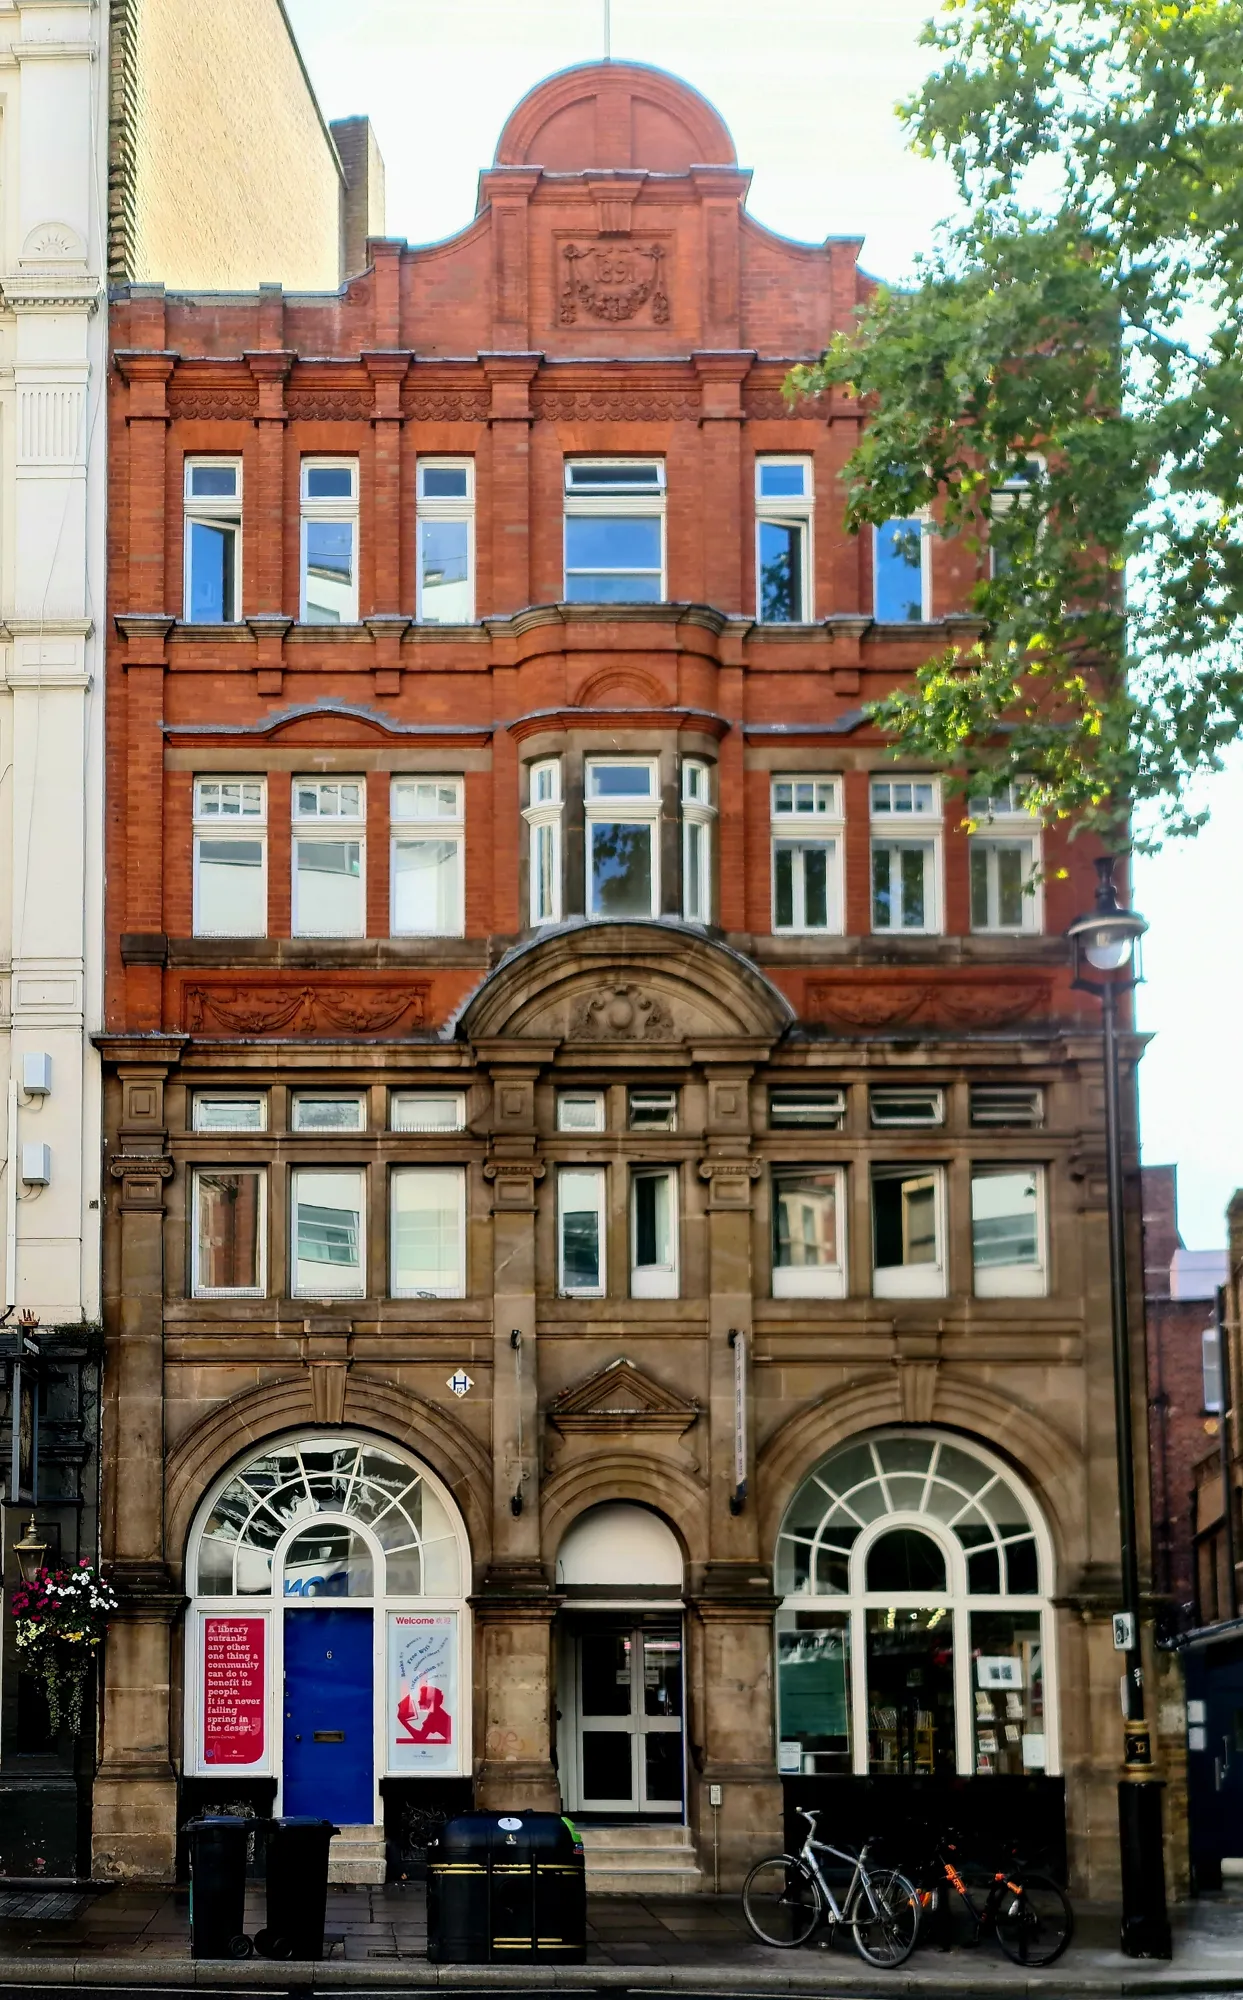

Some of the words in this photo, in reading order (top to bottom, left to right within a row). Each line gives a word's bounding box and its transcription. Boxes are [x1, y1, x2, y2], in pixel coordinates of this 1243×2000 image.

[453, 1375, 467, 1390] H
[395, 1616, 435, 1625] Welcome
[208, 1625, 216, 1633] A
[217, 1625, 249, 1635] library
[207, 1644, 225, 1653] any
[226, 1643, 251, 1651] other
[226, 1652, 251, 1662] thing
[326, 1650, 333, 1660] 6
[207, 1661, 260, 1671] community
[225, 1669, 238, 1678] do
[239, 1670, 249, 1678] to
[207, 1679, 240, 1687] benefit
[241, 1679, 253, 1687] its
[207, 1687, 240, 1698] people.
[207, 1697, 216, 1705] It
[217, 1697, 225, 1705] is
[207, 1706, 238, 1716] failing
[207, 1715, 237, 1725] spring
[239, 1715, 249, 1723] in
[207, 1724, 222, 1732] the
